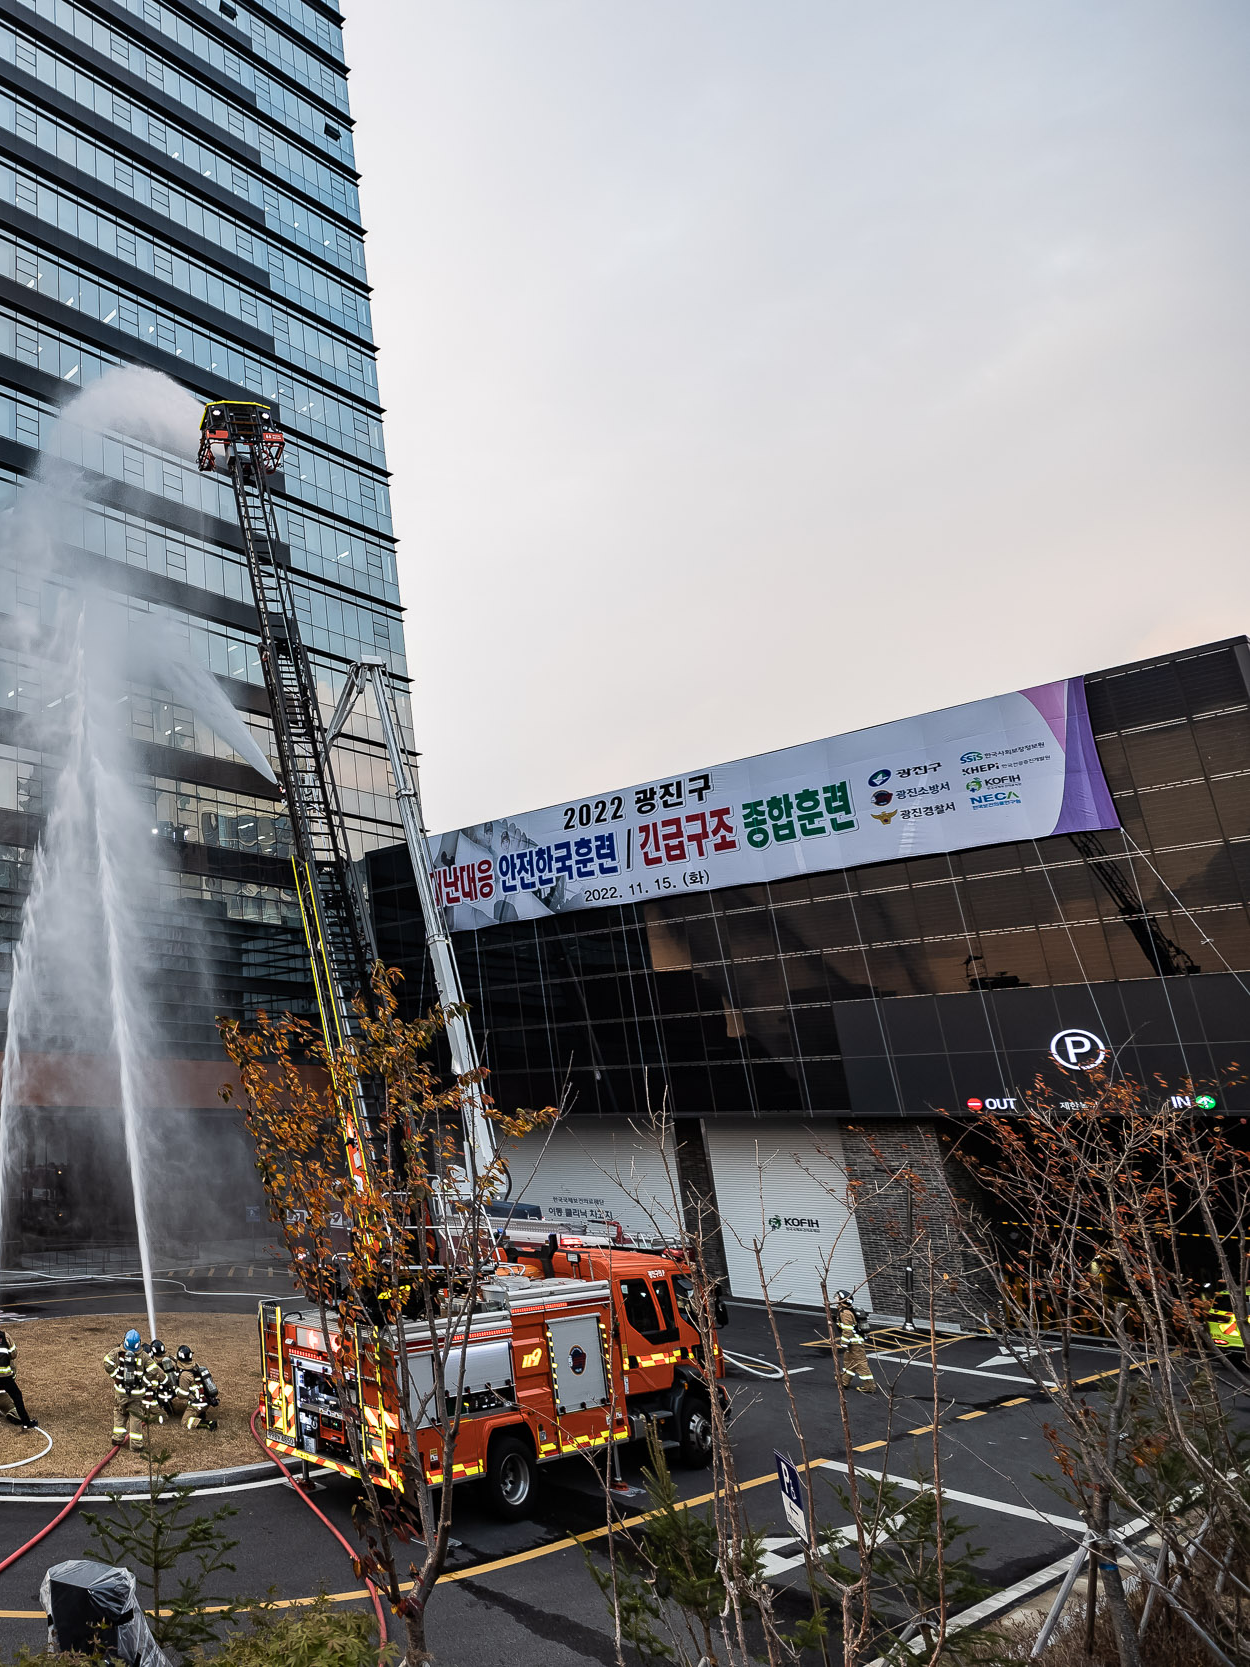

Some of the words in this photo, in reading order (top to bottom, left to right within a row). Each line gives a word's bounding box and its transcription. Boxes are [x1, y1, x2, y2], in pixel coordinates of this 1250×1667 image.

[895, 762, 942, 779] 광진구
[984, 774, 1021, 787] KOFIH
[895, 781, 951, 800] 광진소방서
[969, 791, 1020, 805] NECA
[563, 795, 624, 830] 2022
[634, 773, 712, 815] 광진구
[900, 801, 956, 820] 광진경찰서
[499, 832, 619, 893] 안전한국훈련
[638, 807, 737, 867] 긴급구조
[741, 780, 855, 849] 종합훈련
[584, 886, 623, 902] 2022.
[629, 882, 649, 896] 11.
[654, 877, 677, 891] 15.
[682, 870, 710, 888] (화)
[1064, 1036, 1092, 1063] P
[984, 1098, 1018, 1110] OUT
[1170, 1095, 1192, 1108] IN
[548, 1207, 563, 1217] 이동
[565, 1208, 588, 1219] 클리닉
[783, 1217, 820, 1229] KOFIH
[521, 1347, 543, 1369] 119
[780, 1461, 791, 1495] P
